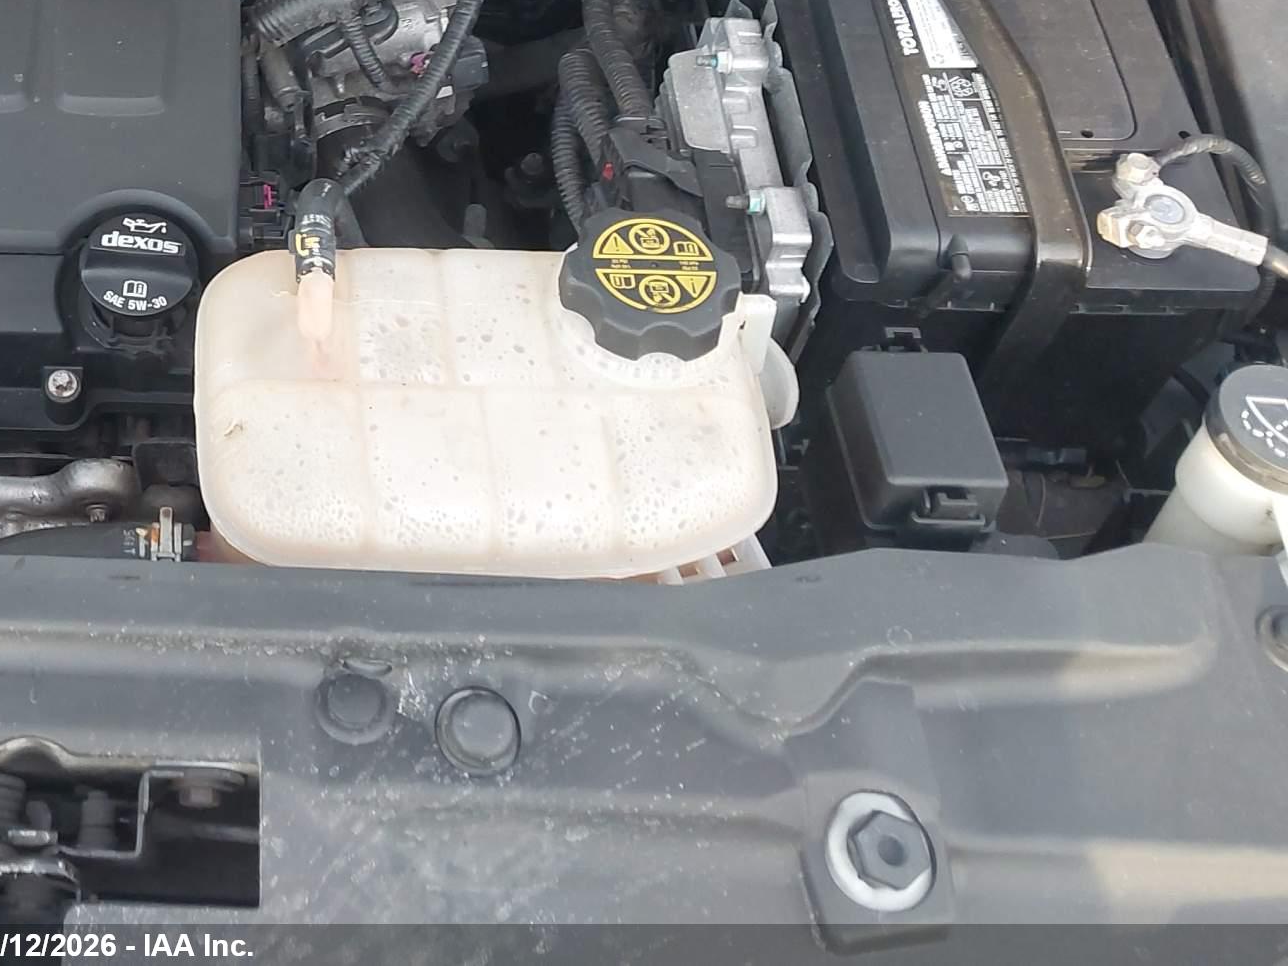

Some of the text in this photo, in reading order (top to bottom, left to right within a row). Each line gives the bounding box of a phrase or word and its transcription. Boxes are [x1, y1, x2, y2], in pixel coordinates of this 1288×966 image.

[100, 230, 183, 254] dexos
[103, 290, 168, 311] SAE 5W-30
